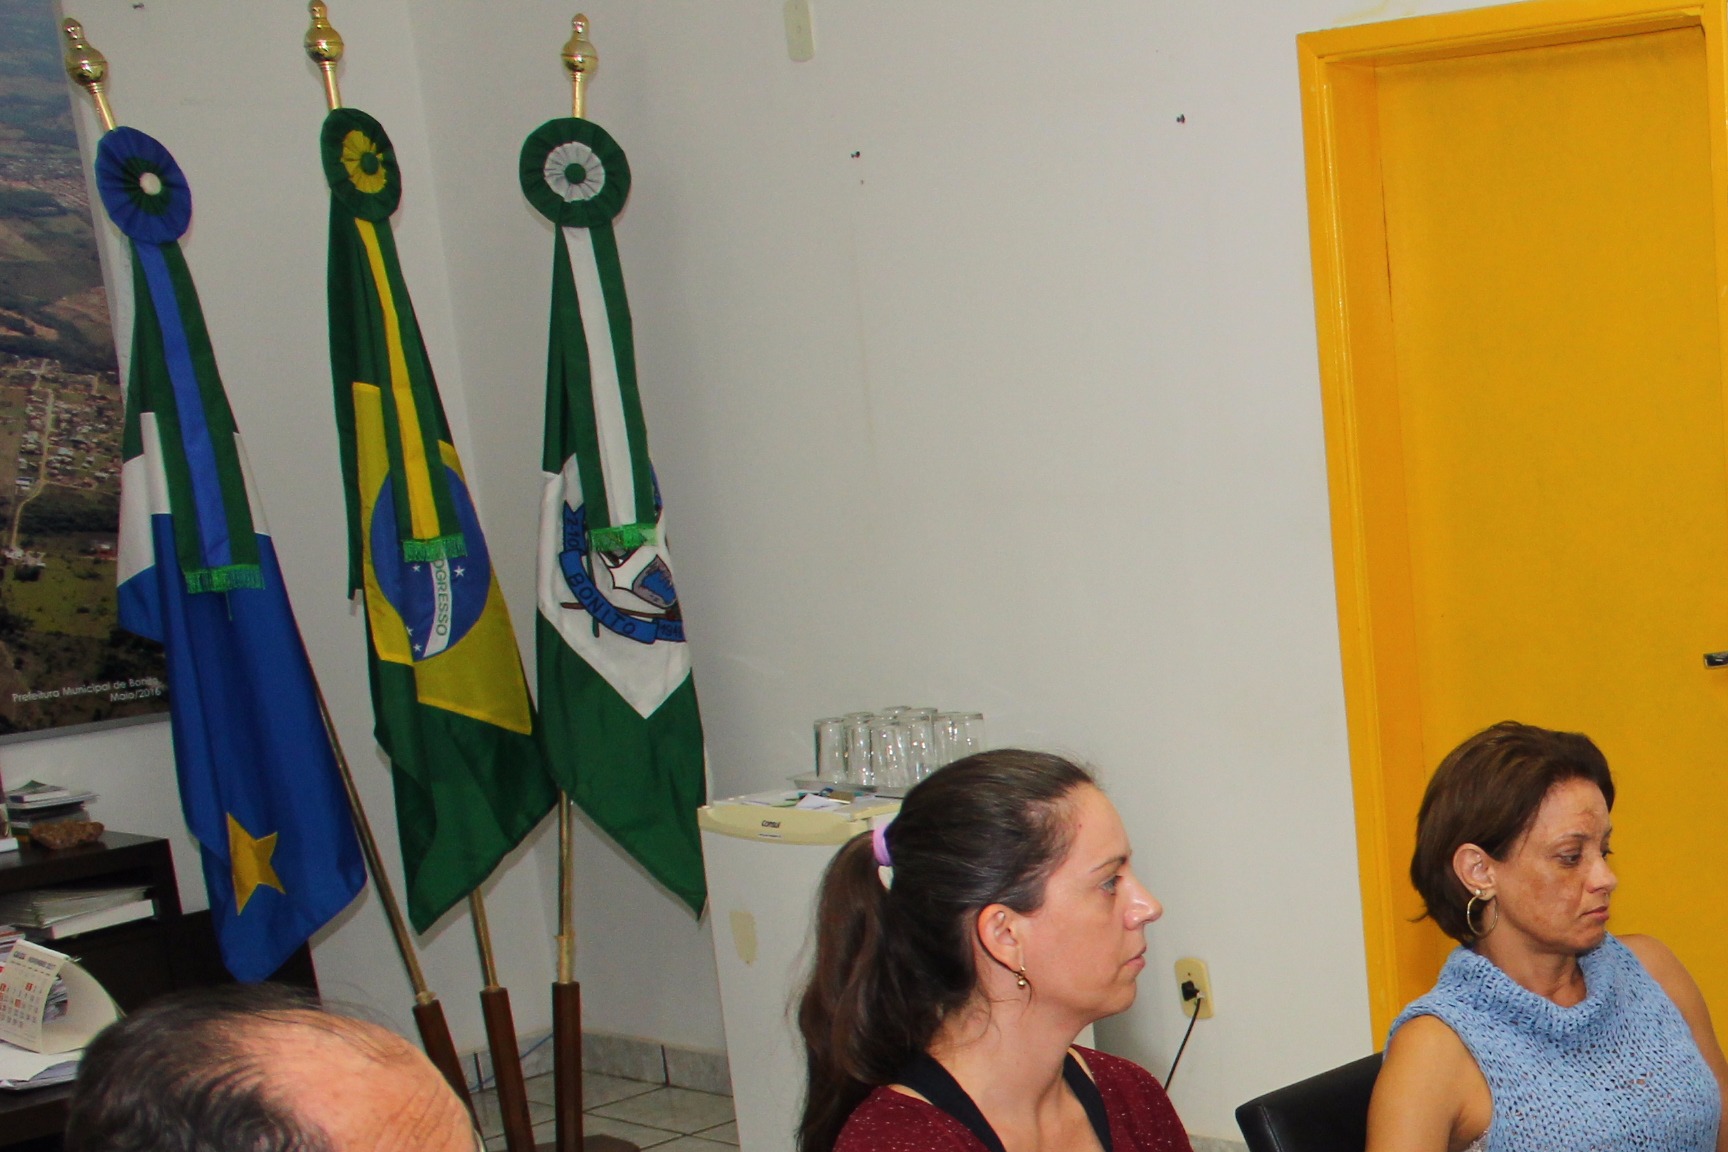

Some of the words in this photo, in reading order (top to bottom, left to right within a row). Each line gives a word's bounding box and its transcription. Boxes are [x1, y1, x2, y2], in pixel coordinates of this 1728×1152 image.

[434, 559, 449, 636] OGRESSO
[568, 573, 636, 635] BONITO
[12, 691, 59, 702] Prefeitura
[63, 683, 111, 695] Municipal
[113, 681, 126, 690] de
[110, 688, 161, 702] Maio/2016
